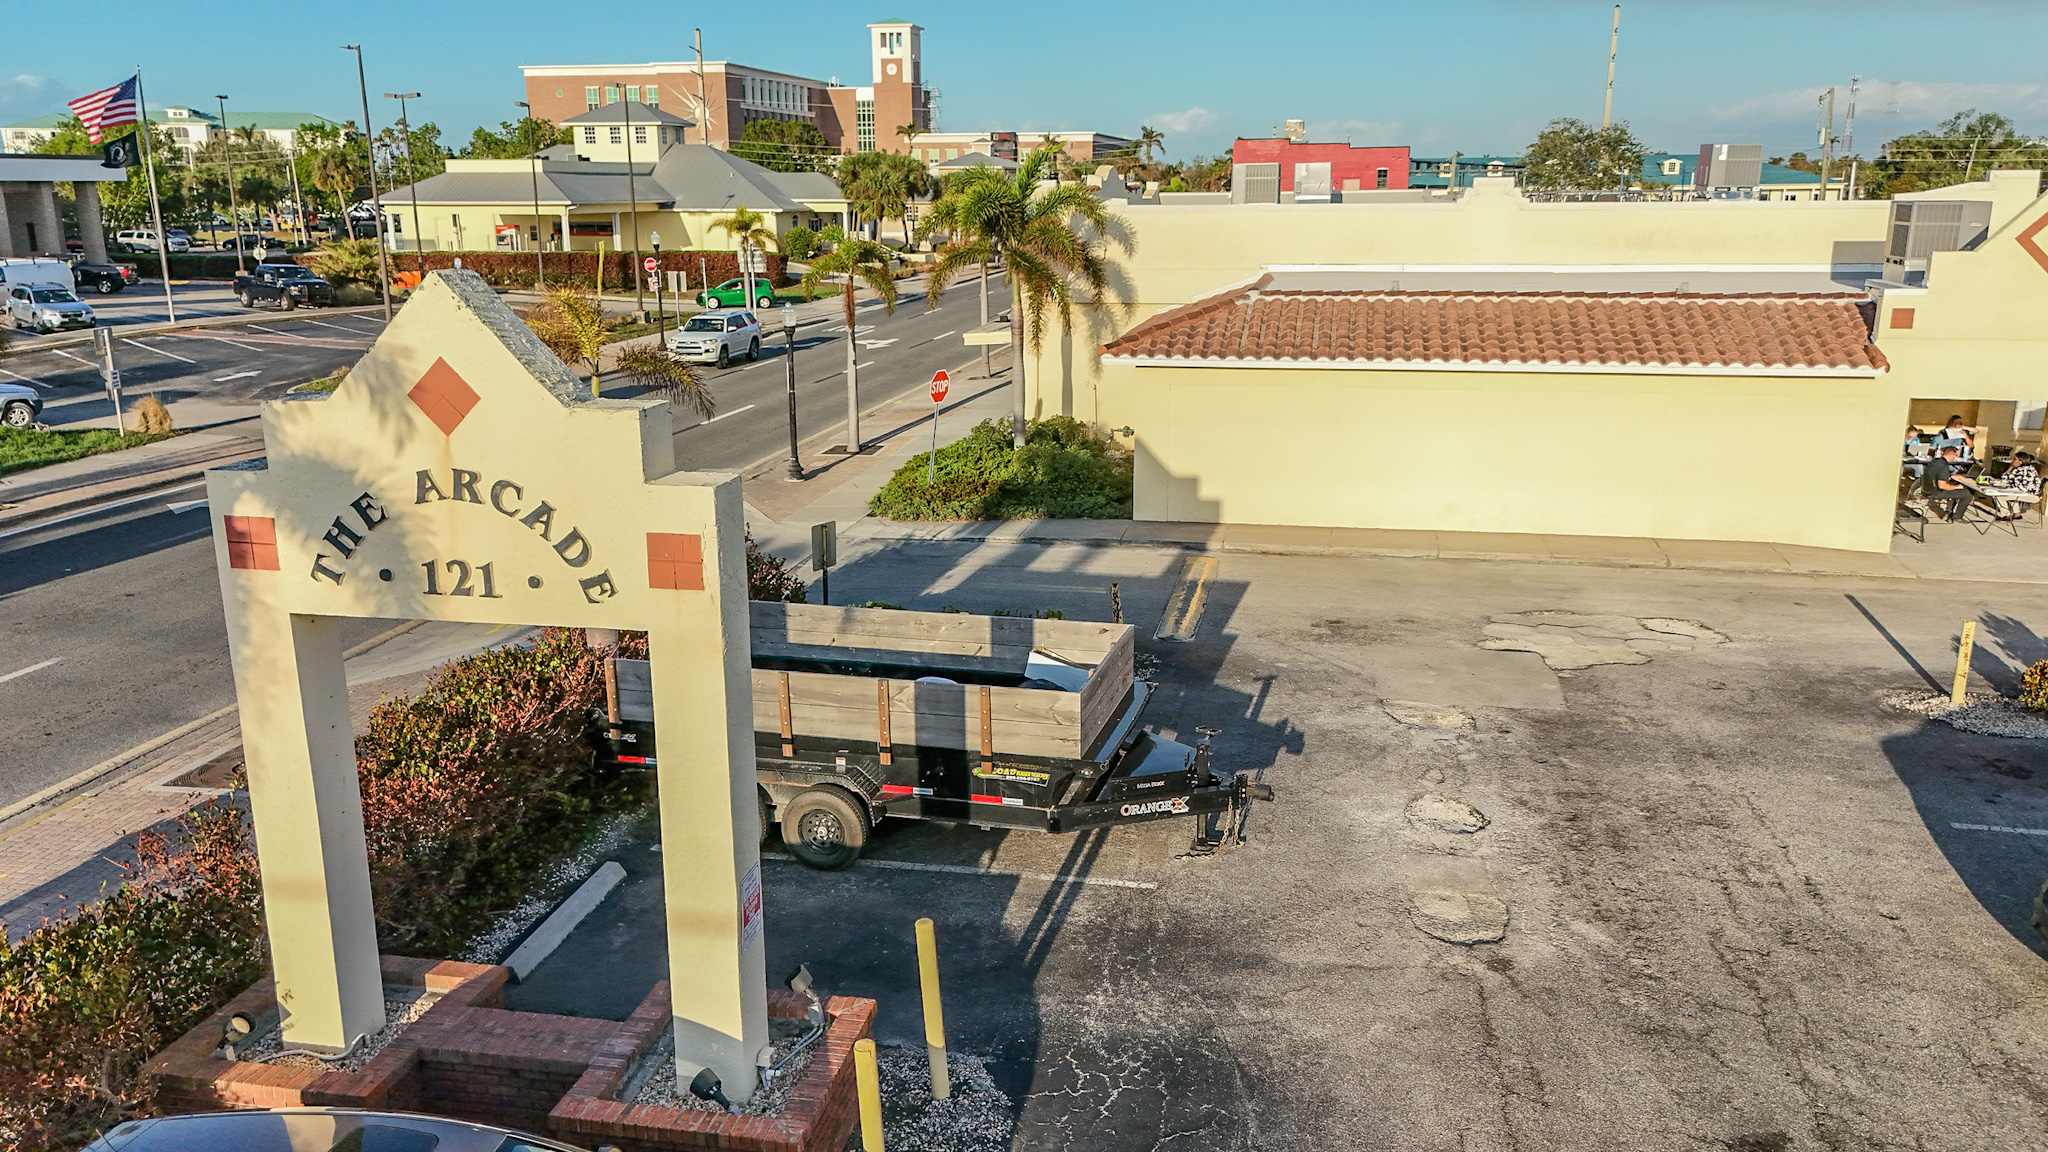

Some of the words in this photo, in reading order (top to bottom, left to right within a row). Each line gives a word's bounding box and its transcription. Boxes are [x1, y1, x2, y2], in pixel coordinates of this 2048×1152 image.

[931, 380, 949, 394] STOP
[311, 493, 388, 586] THE
[415, 468, 618, 604] ARCADE
[422, 558, 502, 598] 121
